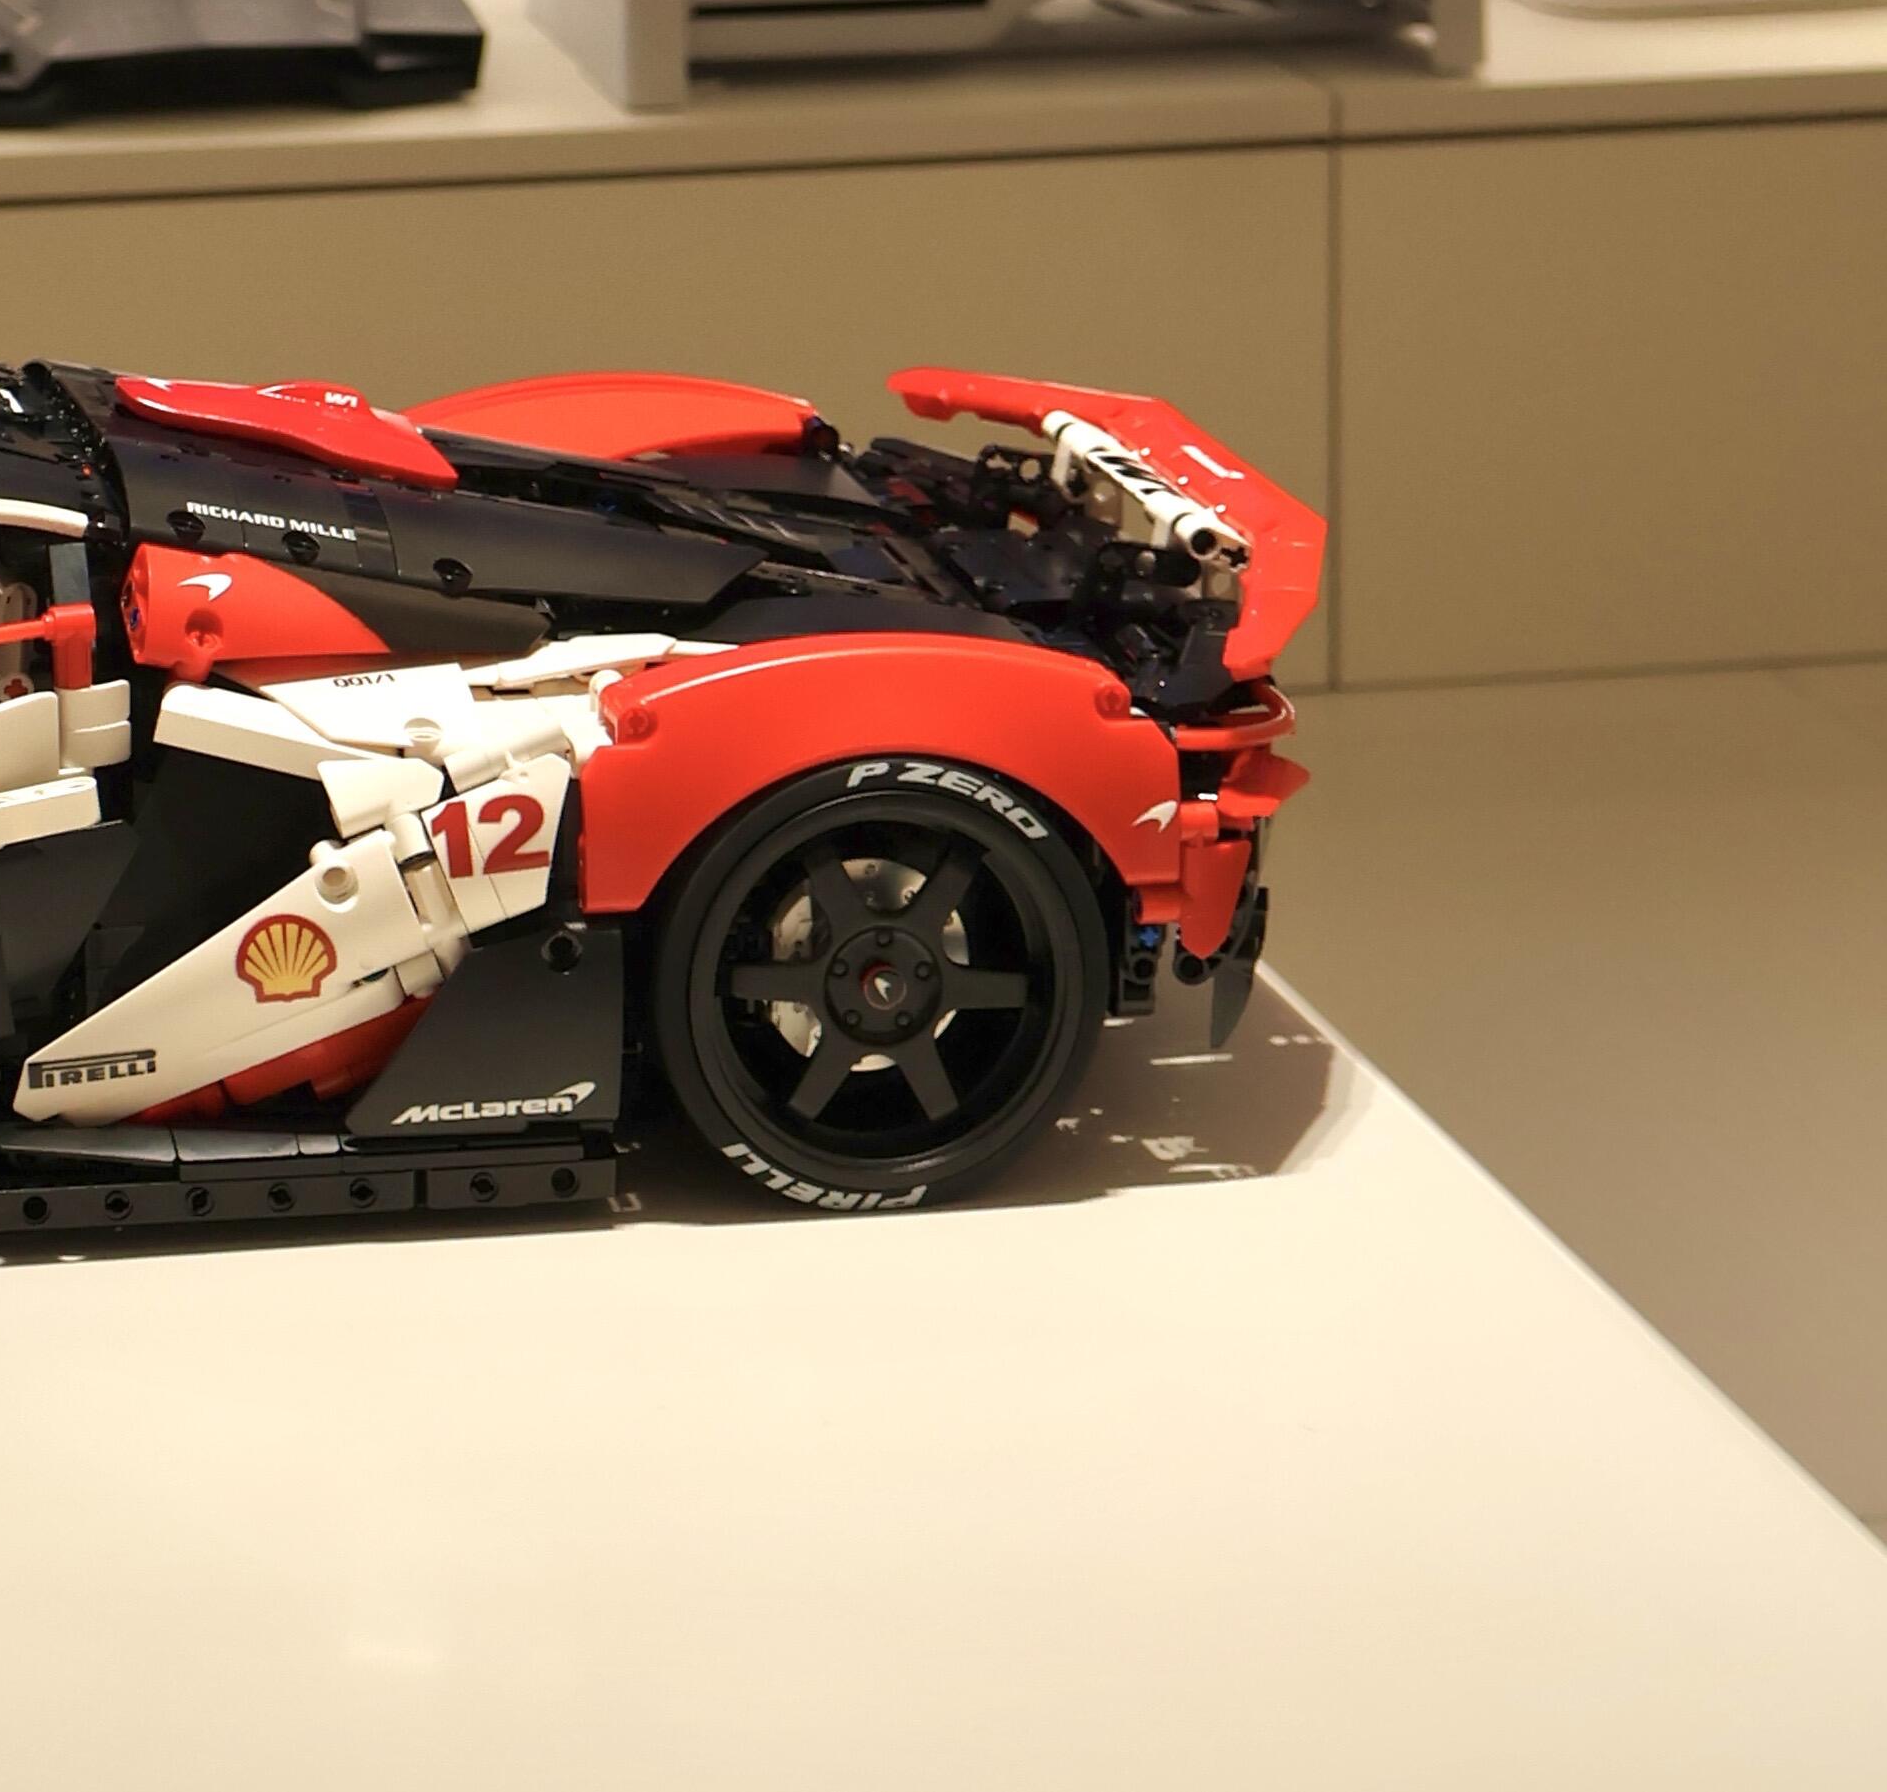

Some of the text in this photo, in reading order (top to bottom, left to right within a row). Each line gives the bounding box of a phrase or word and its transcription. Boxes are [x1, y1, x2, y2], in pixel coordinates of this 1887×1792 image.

[186, 500, 357, 542] RICHARD MILLE
[846, 761, 1049, 841] P ZERO
[430, 794, 551, 880] 12
[27, 1048, 158, 1089] PIRELLI
[390, 1093, 573, 1126] McLaren
[720, 1142, 930, 1212] PIRELLI
